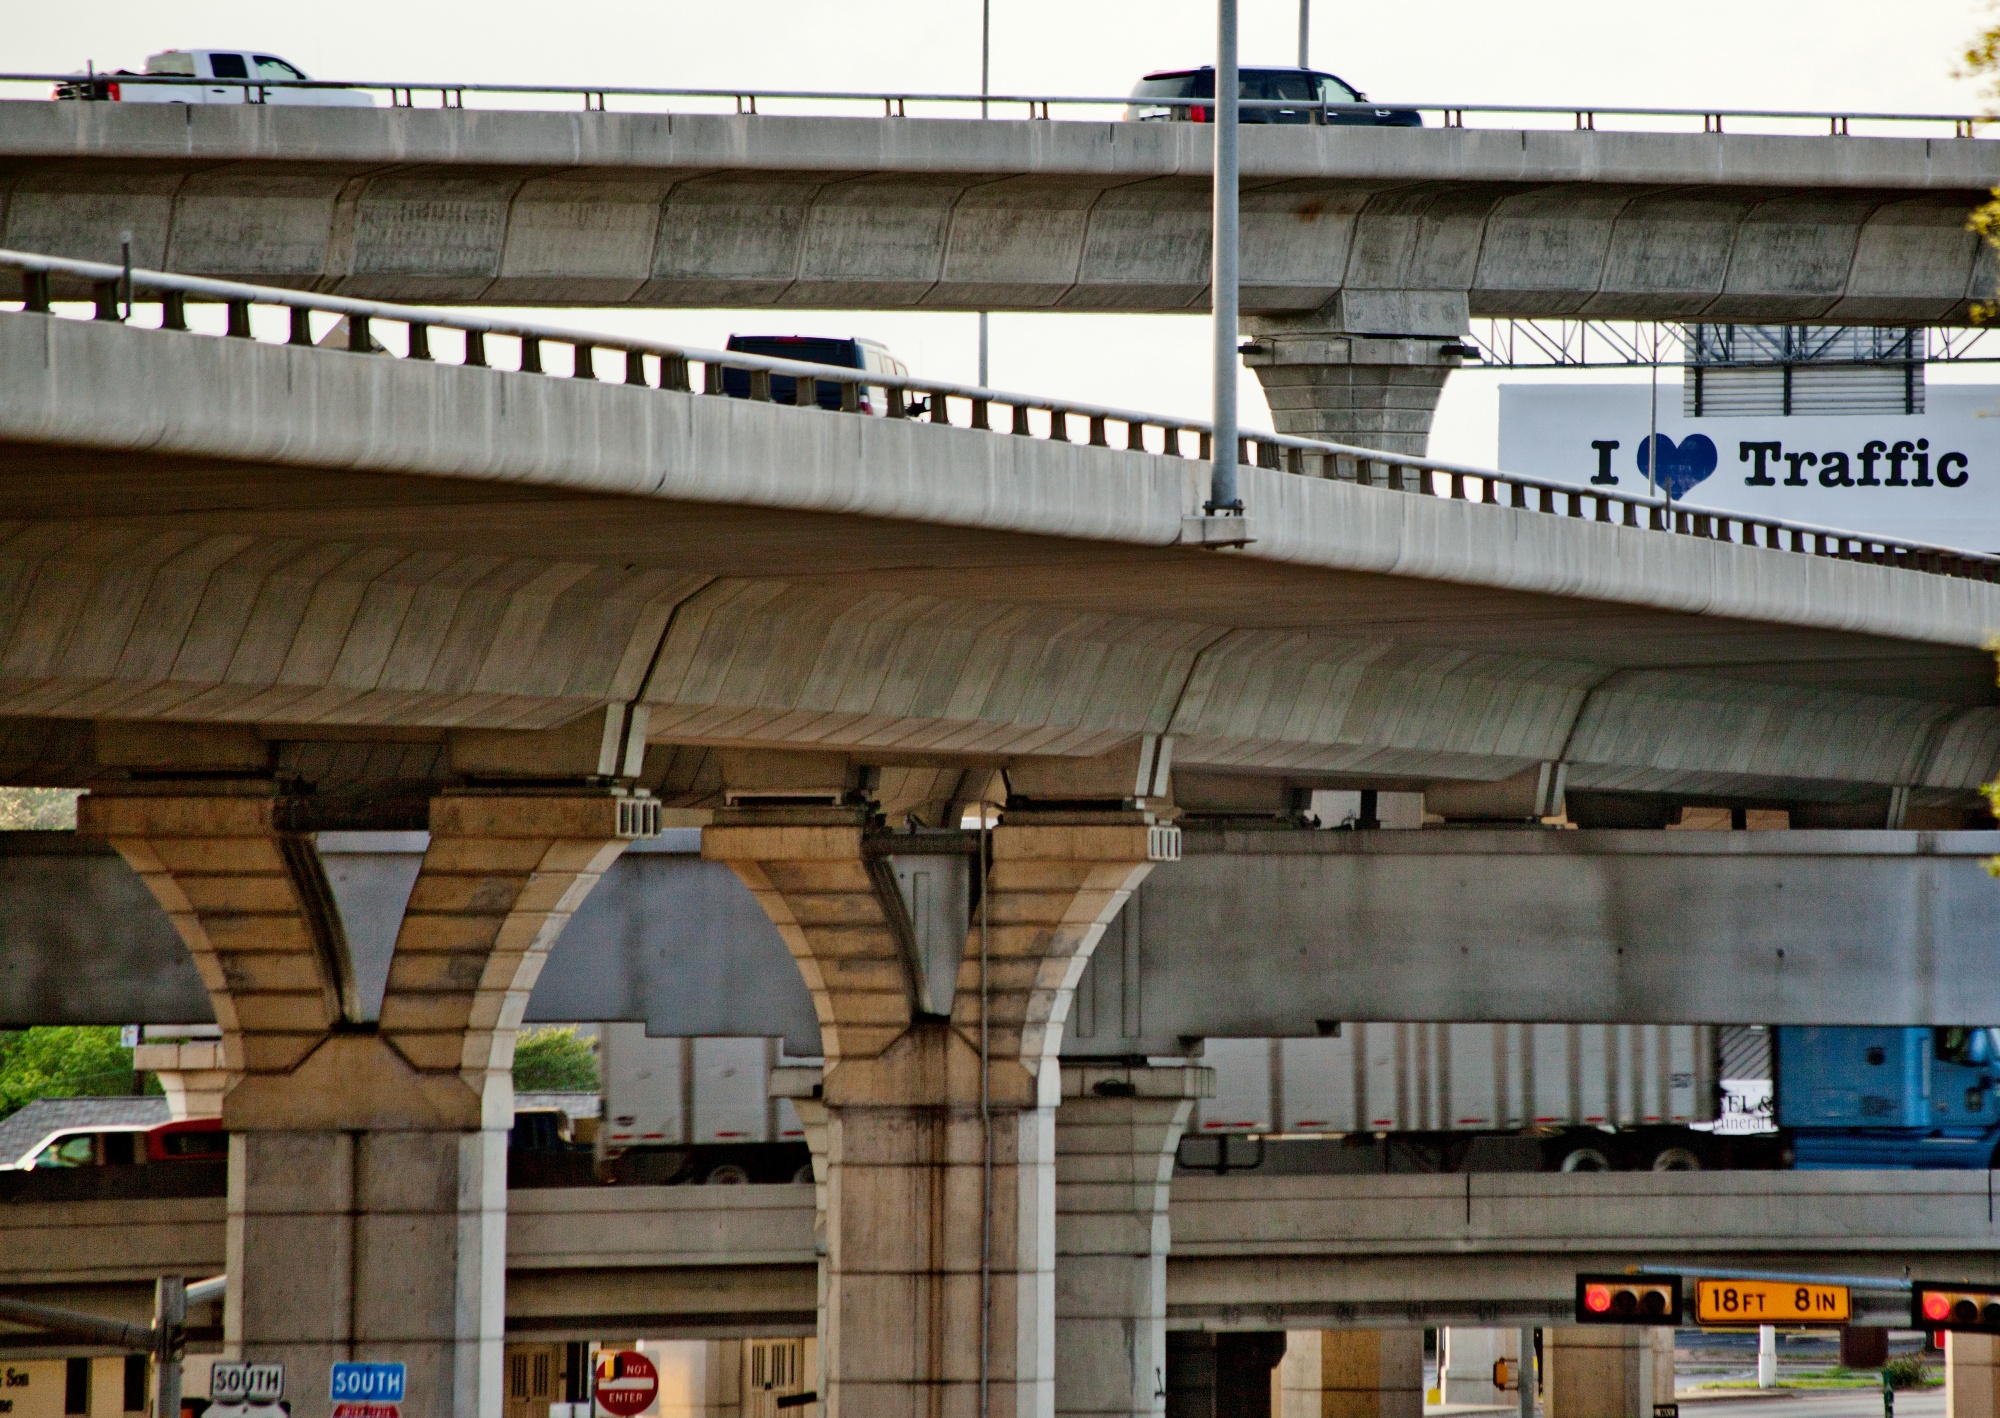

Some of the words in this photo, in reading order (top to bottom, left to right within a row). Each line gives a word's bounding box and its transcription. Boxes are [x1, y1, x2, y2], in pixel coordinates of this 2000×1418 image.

[1590, 440, 1620, 486] I
[1739, 438, 1969, 488] Traffic
[215, 1369, 279, 1392] SOUTH
[626, 1364, 648, 1375] NOT
[335, 1371, 400, 1393] SOUTH
[609, 1392, 643, 1404] ENTER
